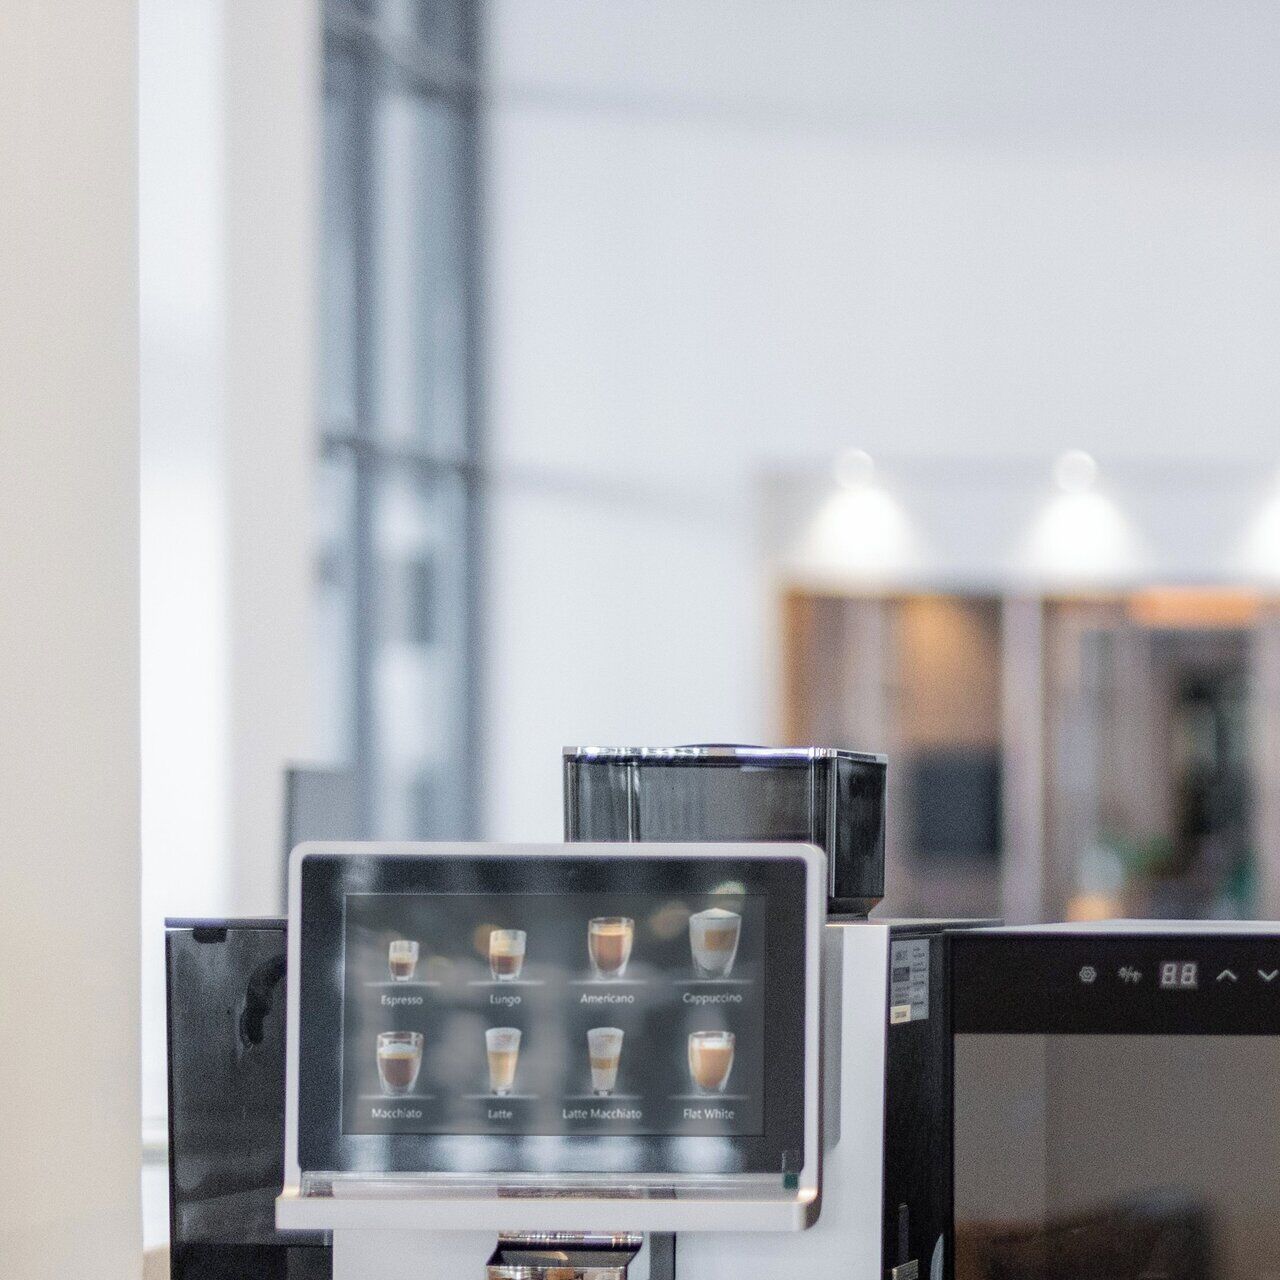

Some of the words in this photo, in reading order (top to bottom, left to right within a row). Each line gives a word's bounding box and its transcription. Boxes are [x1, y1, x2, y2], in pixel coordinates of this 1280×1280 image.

[381, 994, 424, 1006] Espresso
[489, 994, 521, 1007] Lungo
[580, 992, 634, 1004] Americano
[682, 992, 743, 1006] Cappuccino
[371, 1107, 422, 1119] Macchiato
[487, 1108, 513, 1120] Latte
[562, 1108, 588, 1120] Latte
[591, 1107, 642, 1120] Macchiato
[683, 1108, 700, 1120] Flat
[703, 1107, 735, 1120] White
